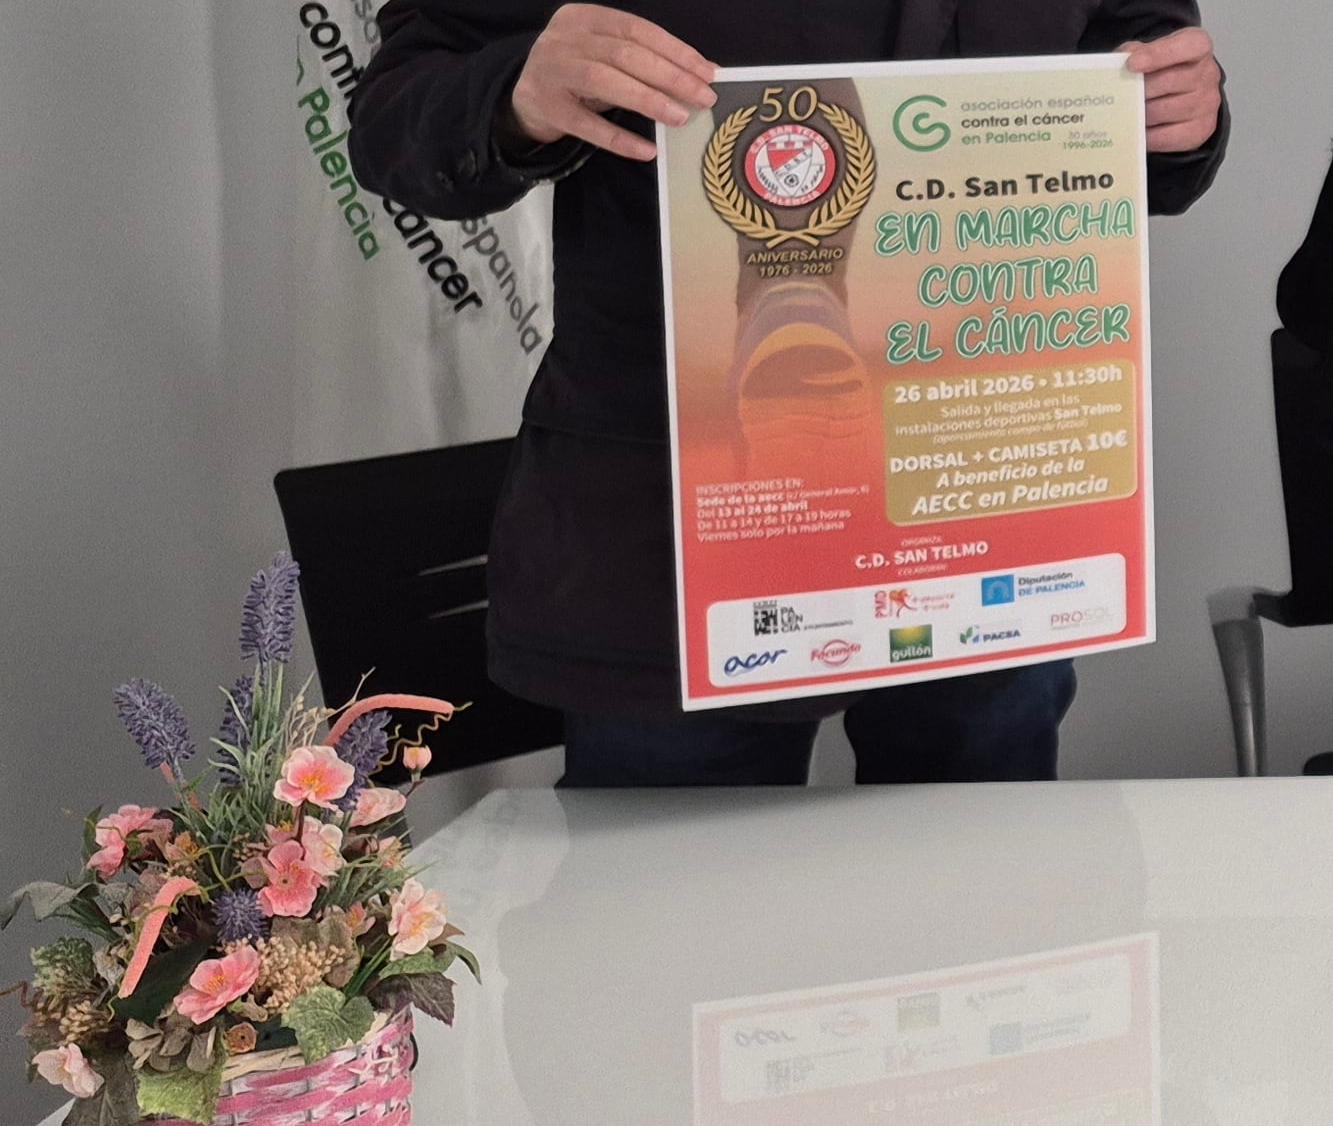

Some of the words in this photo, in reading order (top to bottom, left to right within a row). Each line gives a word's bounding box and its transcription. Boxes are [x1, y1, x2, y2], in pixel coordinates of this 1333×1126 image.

[757, 85, 819, 122] 50
[895, 177, 956, 201] C.D.
[964, 174, 1018, 198] San
[1025, 168, 1113, 194] Telmo
[873, 208, 941, 257] EN
[954, 197, 1136, 252] MARCHA
[916, 252, 1097, 309] CONTRA
[884, 316, 943, 366] EL
[953, 302, 1131, 360] CÁNCER
[893, 384, 920, 404] 26
[925, 379, 976, 401] abril
[981, 374, 1033, 396] 2026
[1051, 366, 1122, 390] 11:30h
[891, 641, 932, 661] gullón
